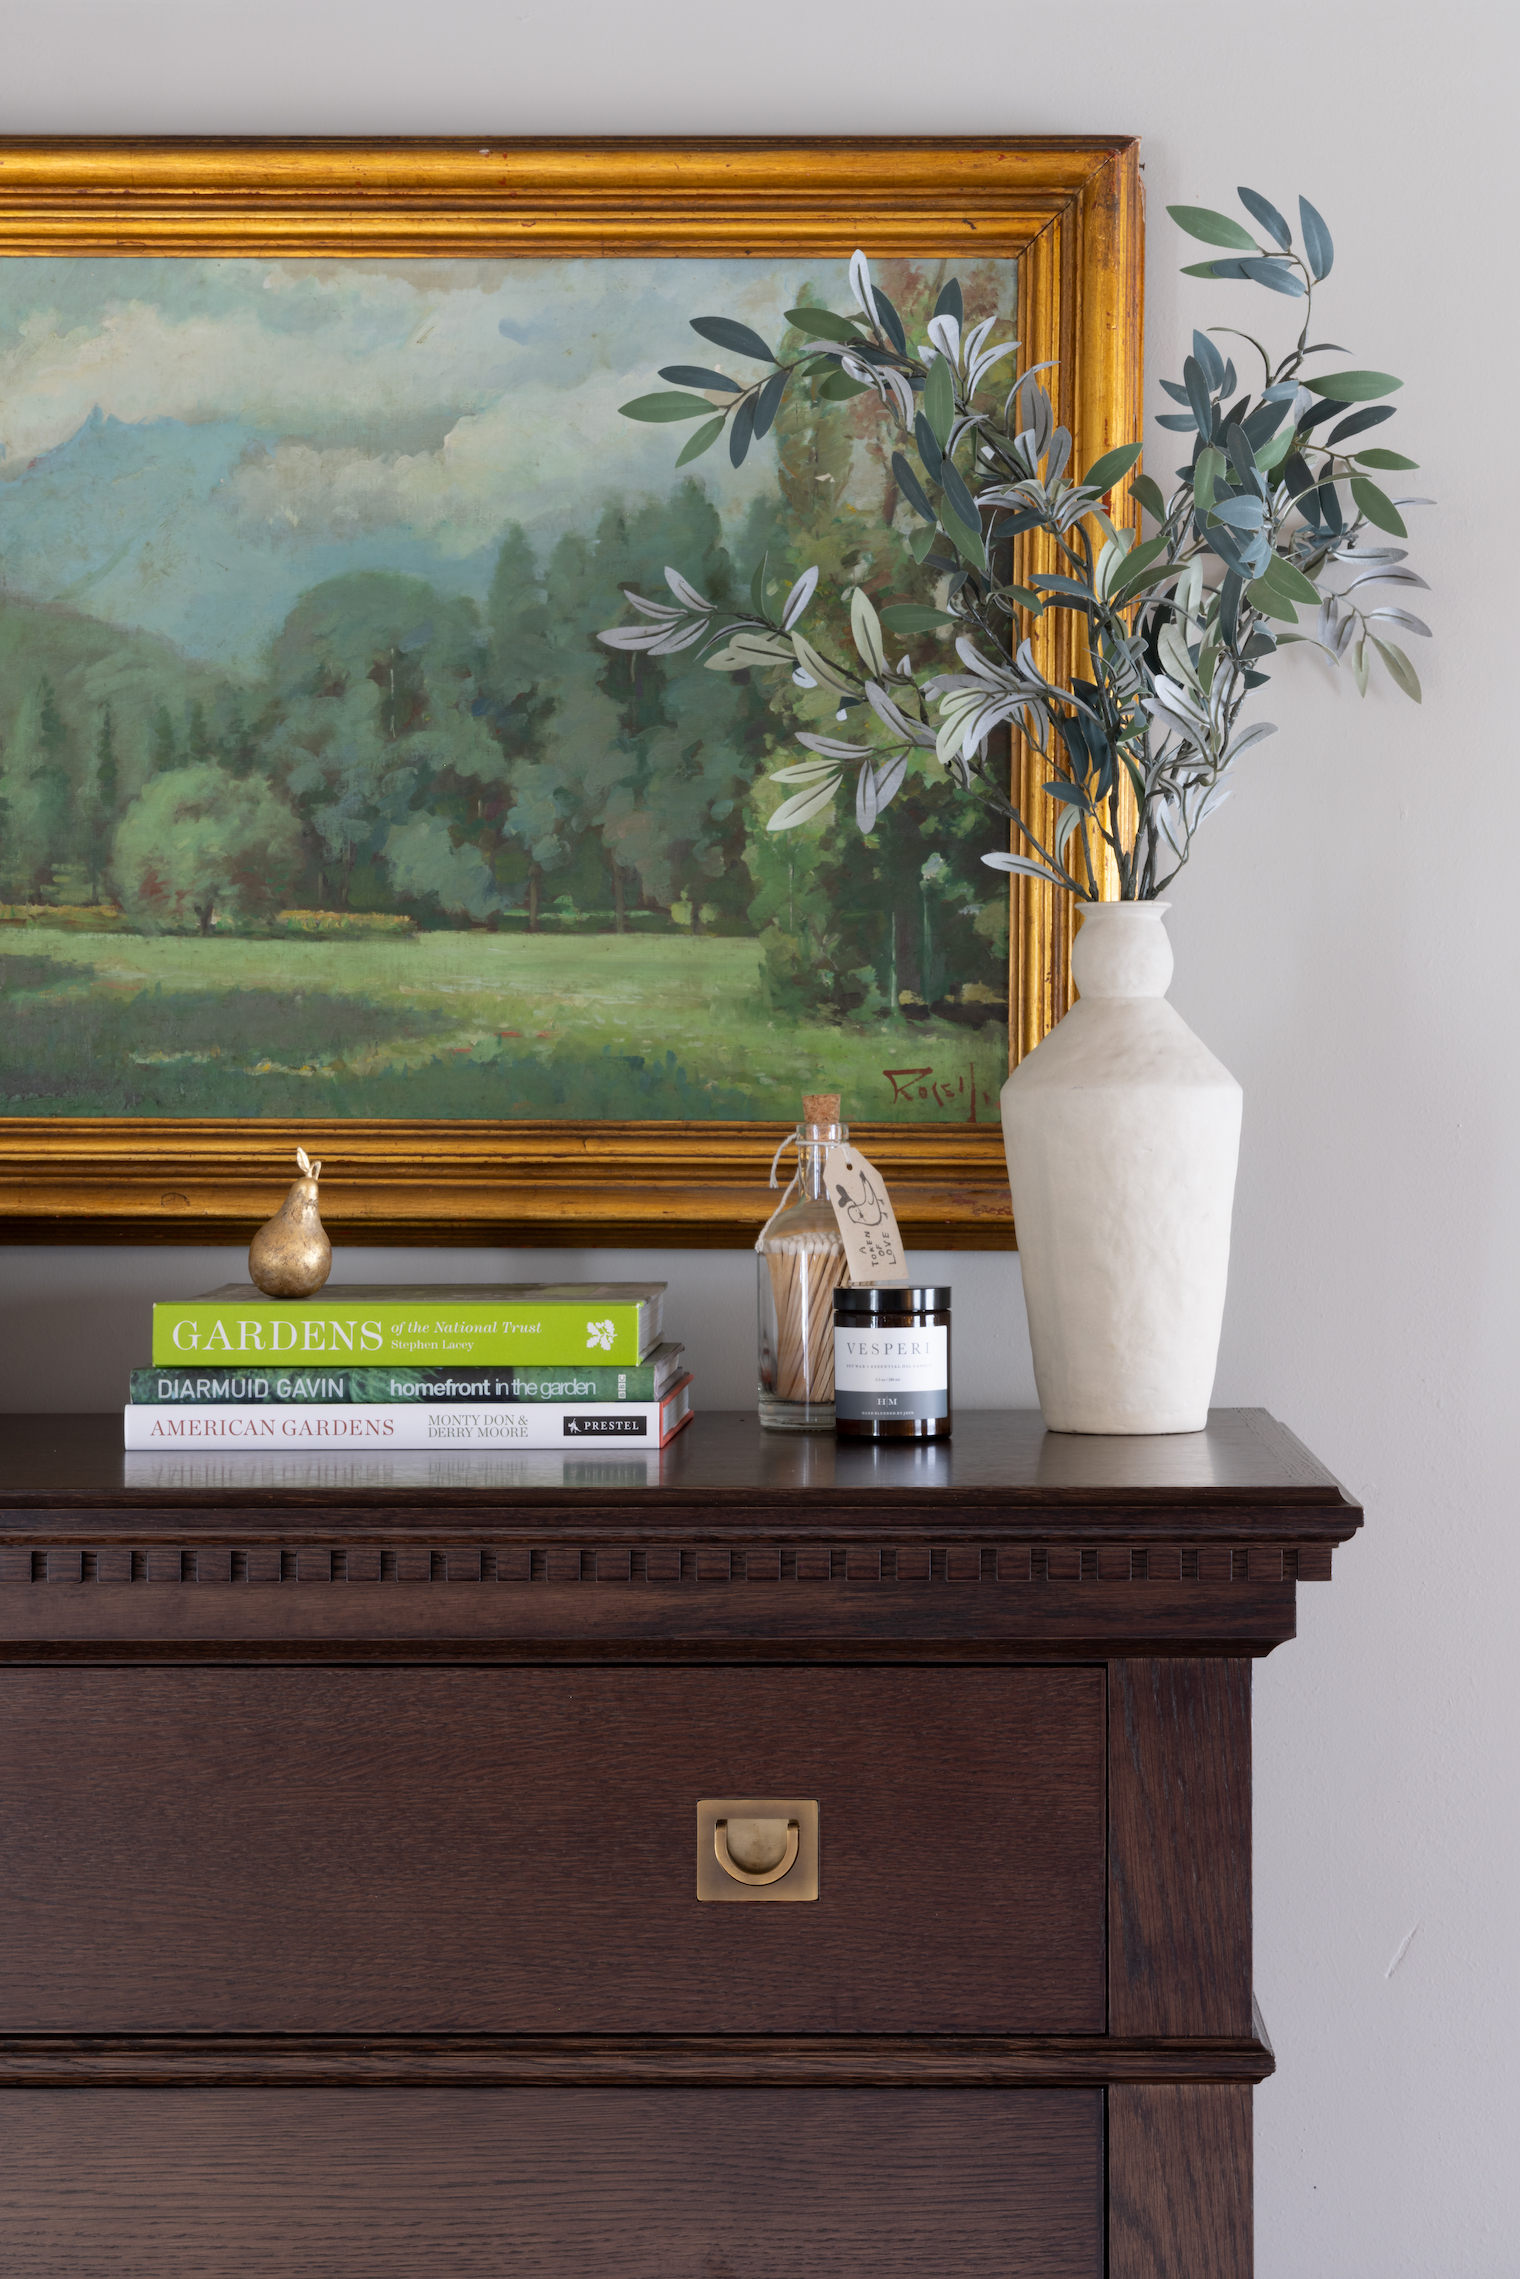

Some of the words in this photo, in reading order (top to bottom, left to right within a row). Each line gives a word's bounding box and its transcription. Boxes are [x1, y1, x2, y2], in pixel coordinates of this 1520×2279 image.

[859, 1246, 867, 1254] A
[864, 1231, 879, 1267] TOKEN
[875, 1244, 885, 1256] OF
[882, 1232, 896, 1265] LOVE
[172, 1320, 384, 1351] GARDENS
[391, 1321, 407, 1336] of
[408, 1321, 431, 1334] the
[433, 1321, 497, 1334] National
[501, 1321, 542, 1334] Trust
[391, 1339, 439, 1352] Stephen
[442, 1339, 474, 1352] Lacey
[846, 1342, 929, 1355] VESPERI
[158, 1378, 269, 1398] DIARMUID
[276, 1378, 344, 1398] GAVIN
[390, 1379, 491, 1396] homefront
[495, 1379, 509, 1396] in
[512, 1378, 538, 1396] the
[540, 1378, 596, 1399] garden
[618, 1374, 626, 1399] BBC
[428, 1414, 481, 1426] MONTY
[484, 1414, 515, 1426] DON
[517, 1414, 529, 1426] &
[584, 1421, 640, 1431] PRESTEL
[150, 1419, 276, 1437] AMERICAN
[282, 1419, 394, 1437] GARDENS
[428, 1427, 475, 1438] DERRY
[477, 1427, 529, 1438] MOORE
